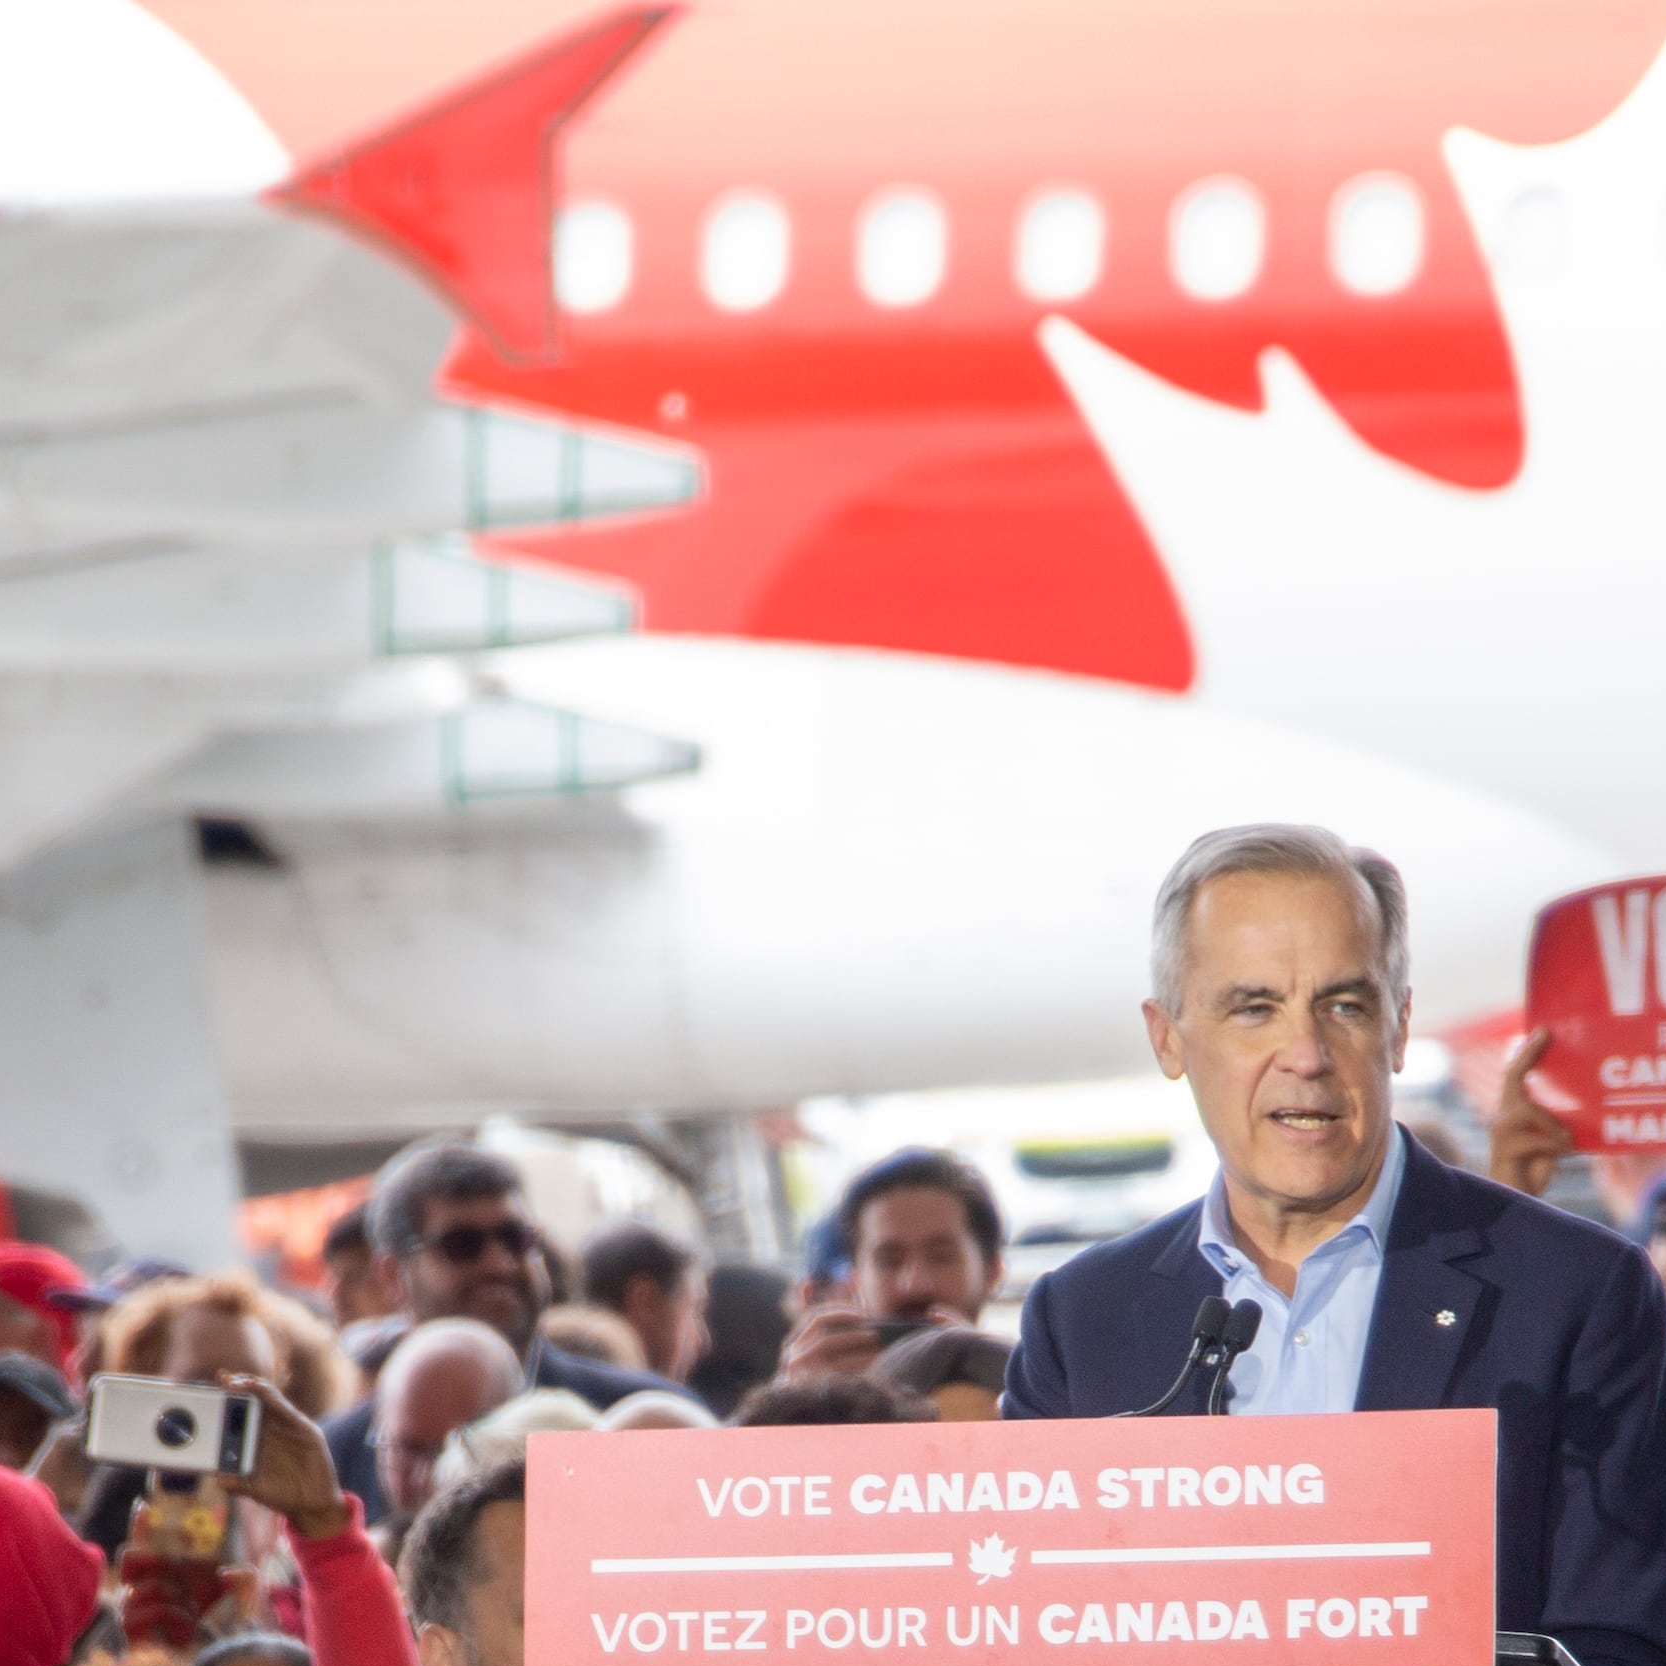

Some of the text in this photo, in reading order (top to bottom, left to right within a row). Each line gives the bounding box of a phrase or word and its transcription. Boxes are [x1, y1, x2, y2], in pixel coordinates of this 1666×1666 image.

[695, 1462, 1326, 1518] VOTE CANADA STRONG
[590, 1595, 1429, 1654] VOTEZ POUR UN CANADA FORT
